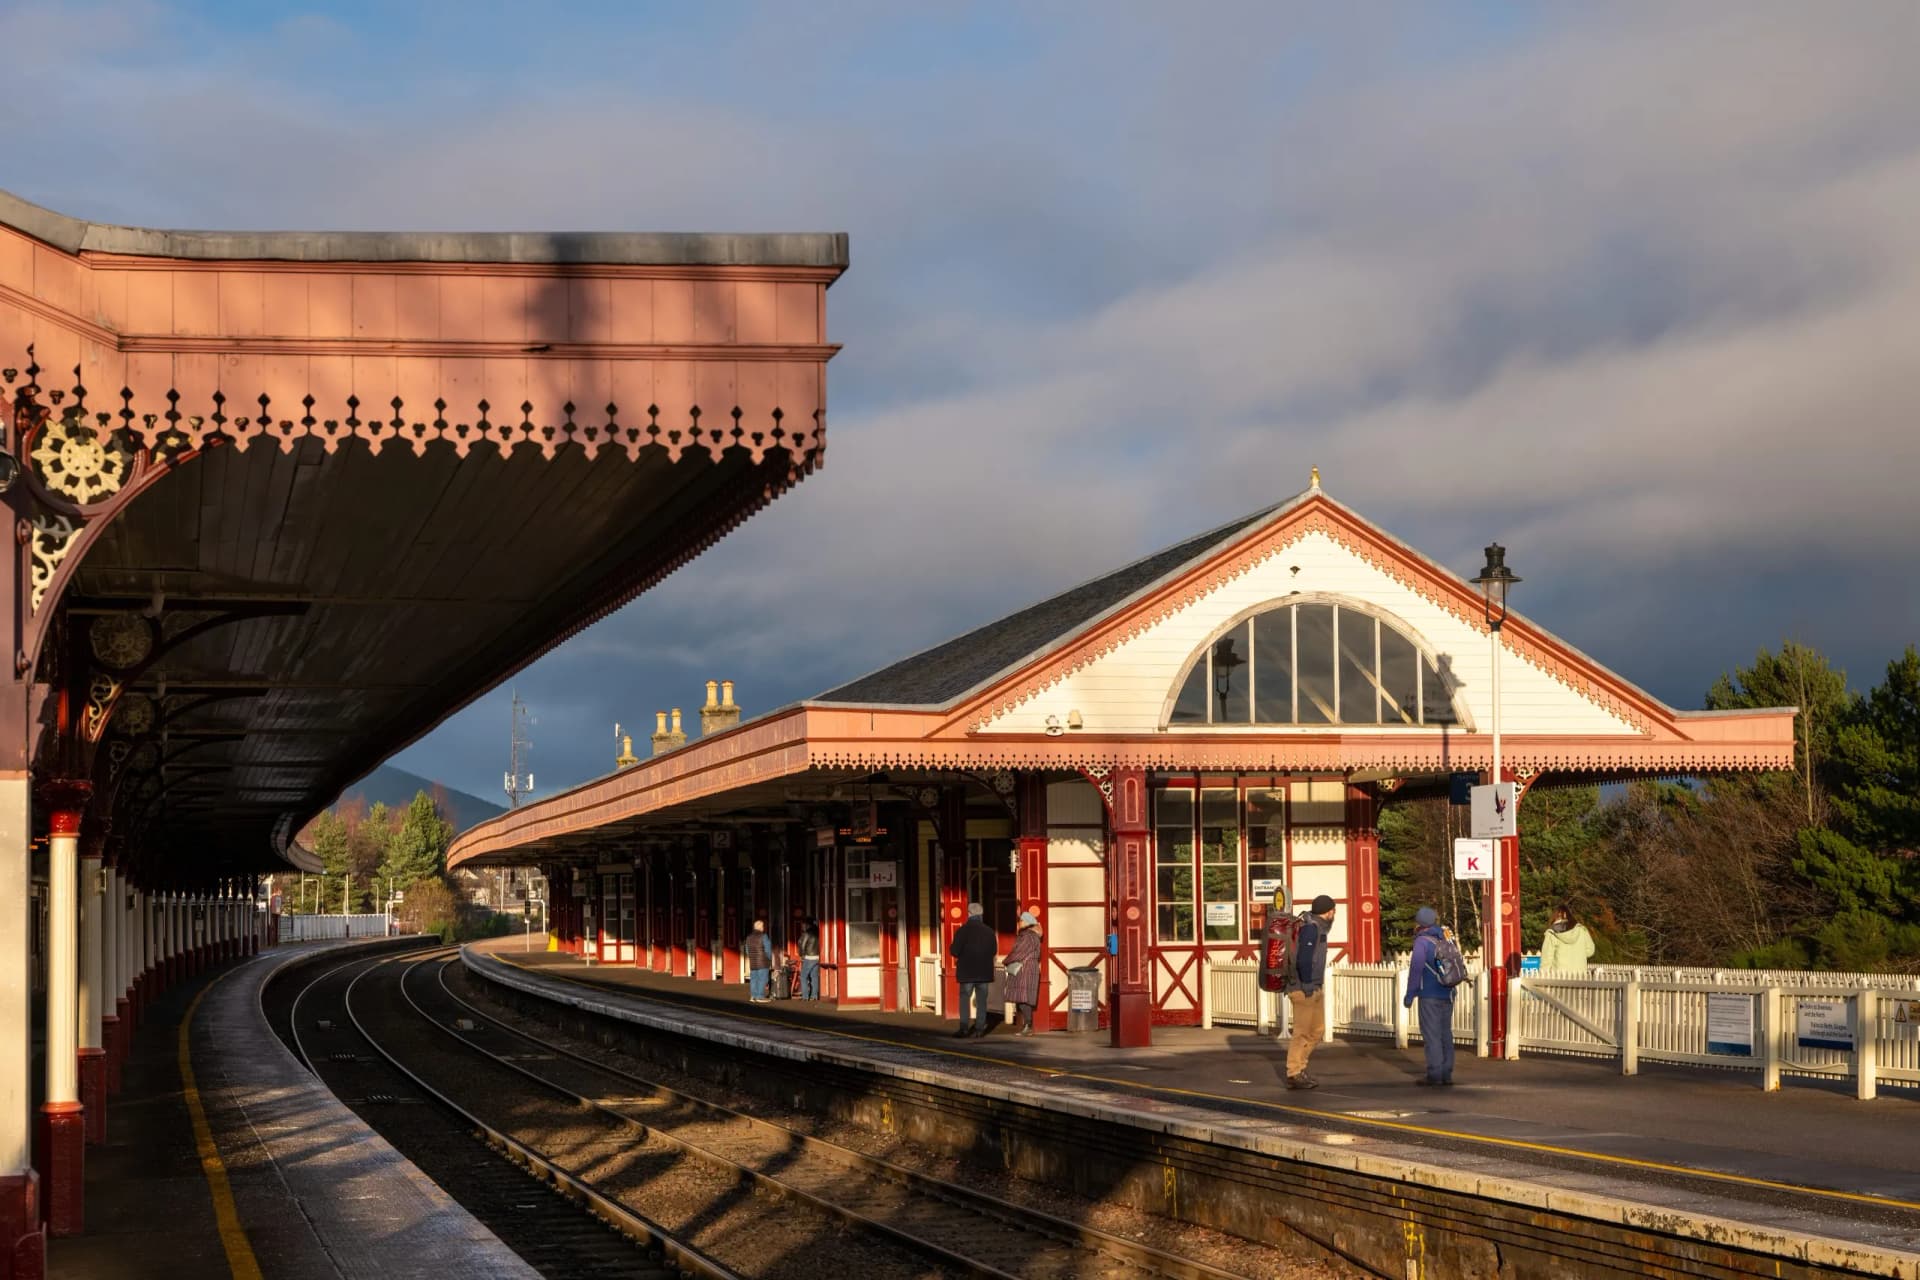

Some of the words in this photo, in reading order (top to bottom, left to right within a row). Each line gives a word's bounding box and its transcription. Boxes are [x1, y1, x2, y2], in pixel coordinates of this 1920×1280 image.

[717, 832, 728, 846] 2
[1467, 857, 1479, 870] K
[873, 872, 893, 882] H-J
